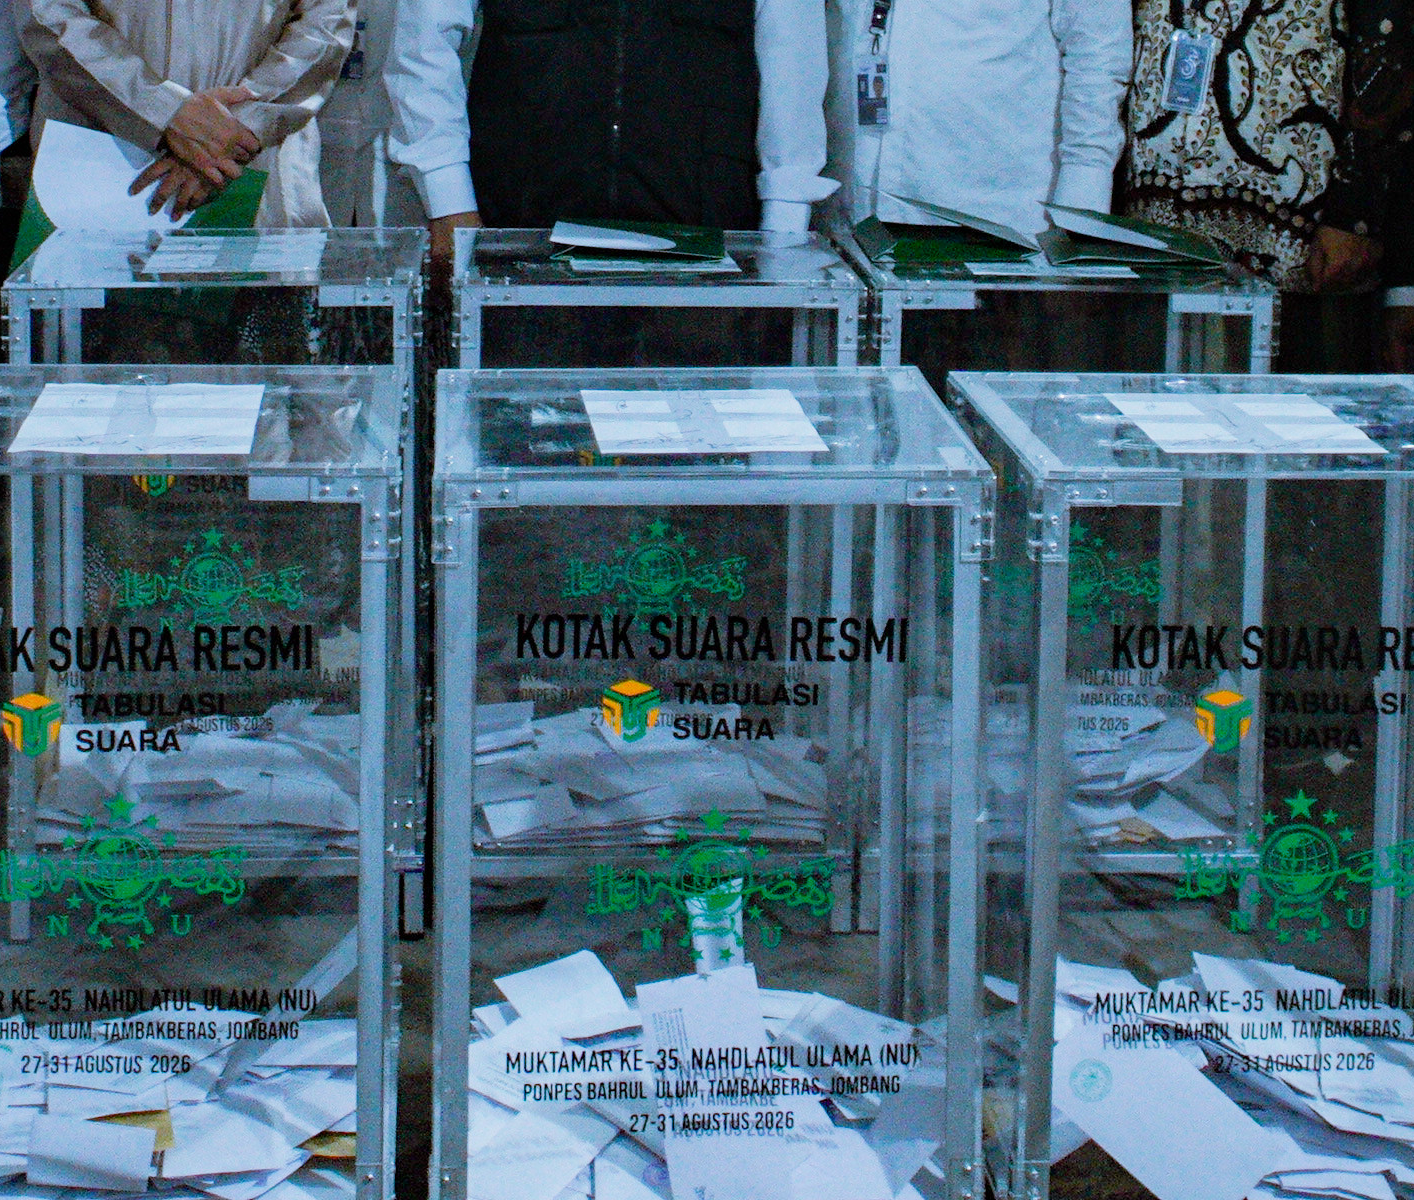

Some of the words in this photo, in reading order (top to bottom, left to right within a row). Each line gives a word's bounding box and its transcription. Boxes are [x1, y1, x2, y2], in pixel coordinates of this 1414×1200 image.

[186, 474, 247, 494] SUAR
[48, 626, 180, 673] SUARA
[192, 624, 314, 672] RESMI
[516, 613, 637, 660] KOTAK
[648, 615, 776, 661] SUARA
[789, 616, 908, 663] RESMI
[1111, 624, 1229, 671] KOTAK
[1240, 625, 1365, 672] SUARA
[75, 693, 226, 718] TABULASI
[673, 682, 819, 707] TABULASI
[1265, 691, 1407, 717] TABULASI
[76, 728, 182, 753] SUARA
[672, 717, 775, 741] SUARA
[1264, 725, 1363, 750] SUARA
[46, 914, 69, 937] N
[171, 914, 193, 936] U
[1346, 908, 1366, 930] U
[11, 988, 72, 1013] KE-35
[85, 988, 196, 1013] NAHDLATUL
[203, 988, 271, 1012] ULAMA
[278, 987, 317, 1012] (NU)
[1095, 990, 1200, 1015] MUKTAMAR
[1207, 989, 1264, 1013] KE-35
[1276, 987, 1381, 1012] NAHDLATUL
[104, 1021, 221, 1043] TAMBAKBERAS,
[226, 1021, 300, 1041] JOMBANG
[1112, 1023, 1170, 1042] PONPES
[1174, 1022, 1232, 1041] BAHRUL
[1291, 1018, 1406, 1039] TAMBAKBERAS,
[21, 1055, 72, 1074] 27-31
[74, 1055, 142, 1074] AGUSTUS
[150, 1054, 191, 1074] 2026
[506, 1050, 613, 1074] MUKTAMAR
[620, 1048, 679, 1072] KE-35
[691, 1045, 800, 1070] NAHDLATUL
[806, 1044, 873, 1068] ULAMA
[880, 1043, 918, 1068] (NU)
[1213, 1055, 1260, 1074] 27-31
[1264, 1053, 1332, 1073] AGUSTUS
[1336, 1052, 1375, 1071] 2026
[523, 1082, 582, 1102] PONPES
[587, 1080, 647, 1100] BAHRUL
[708, 1076, 826, 1098] TAMBAKBERAS,
[830, 1075, 901, 1096] JOMBANG
[629, 1113, 676, 1133] 27-31
[682, 1111, 750, 1131] AGUSTUS
[755, 1111, 795, 1130] 2026
